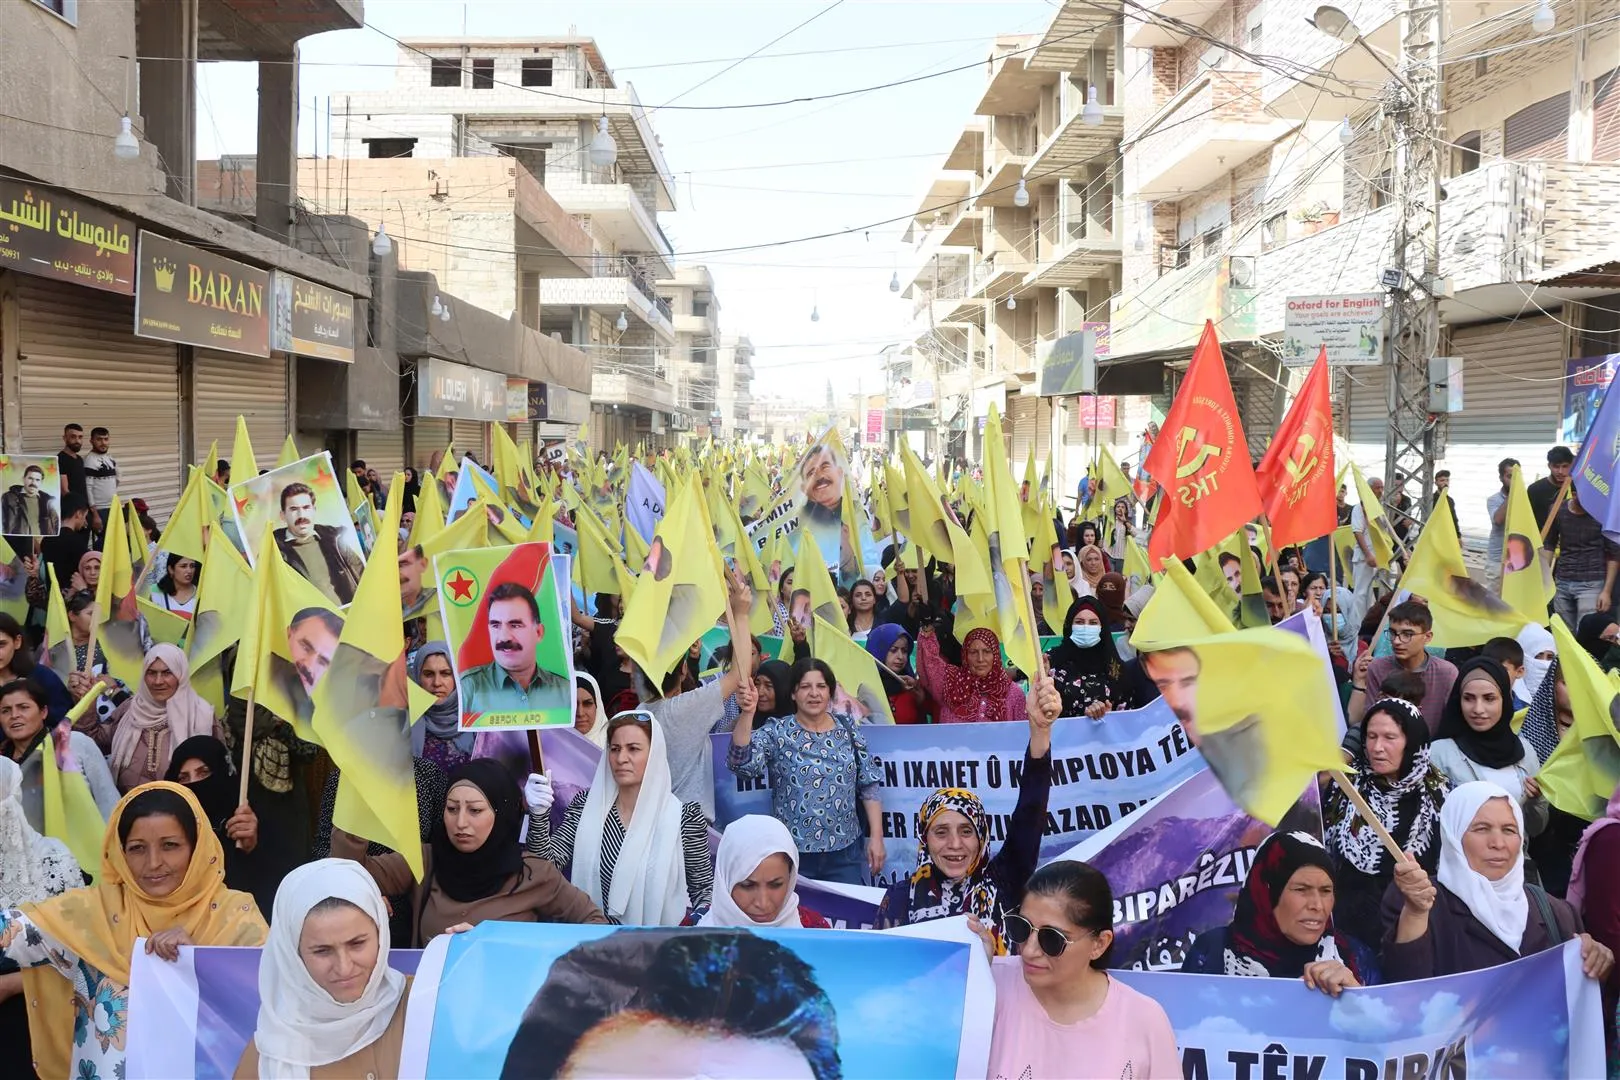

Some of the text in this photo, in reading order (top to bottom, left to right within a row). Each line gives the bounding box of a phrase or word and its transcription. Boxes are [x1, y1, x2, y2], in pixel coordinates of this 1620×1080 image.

[0, 190, 129, 258] ملبوسات الشي
[187, 263, 263, 318] BARAN
[1288, 298, 1380, 310] Oxford for English
[1311, 310, 1328, 319] goals
[434, 376, 467, 402] ALOUSH
[904, 760, 979, 788] IXANET
[987, 754, 1001, 789] Û
[1009, 747, 1156, 788] KMPLOYA
[1157, 723, 1195, 764] TÊ
[1042, 803, 1112, 837] AZAD
